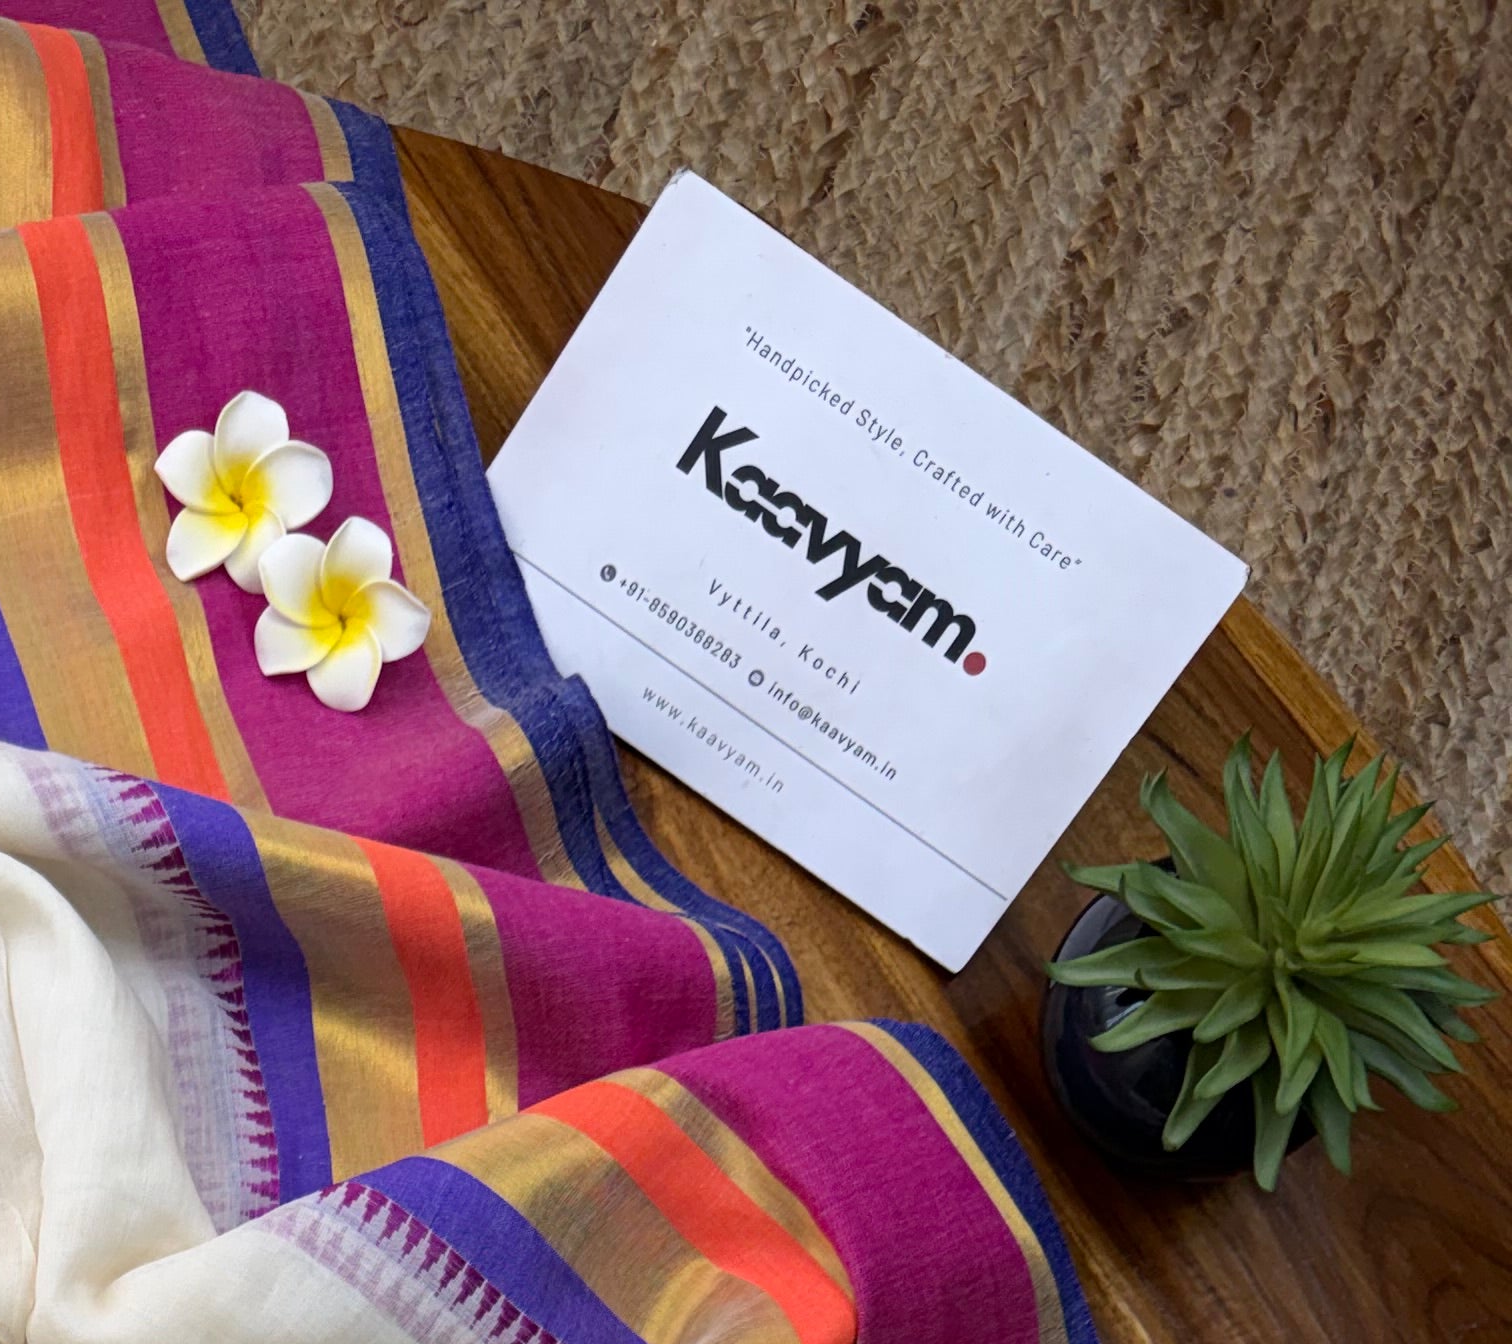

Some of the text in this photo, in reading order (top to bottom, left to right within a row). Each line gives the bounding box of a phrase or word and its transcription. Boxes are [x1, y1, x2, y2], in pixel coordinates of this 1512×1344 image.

[745, 325, 856, 416] "Handpicked
[855, 408, 905, 457] Style,
[912, 449, 985, 508] Crafted
[985, 502, 1026, 539] with
[708, 577, 861, 695] Vyttila, Kochi
[642, 687, 785, 793] www.kaavyam.in
[767, 680, 897, 781] info@kaavyam.in
